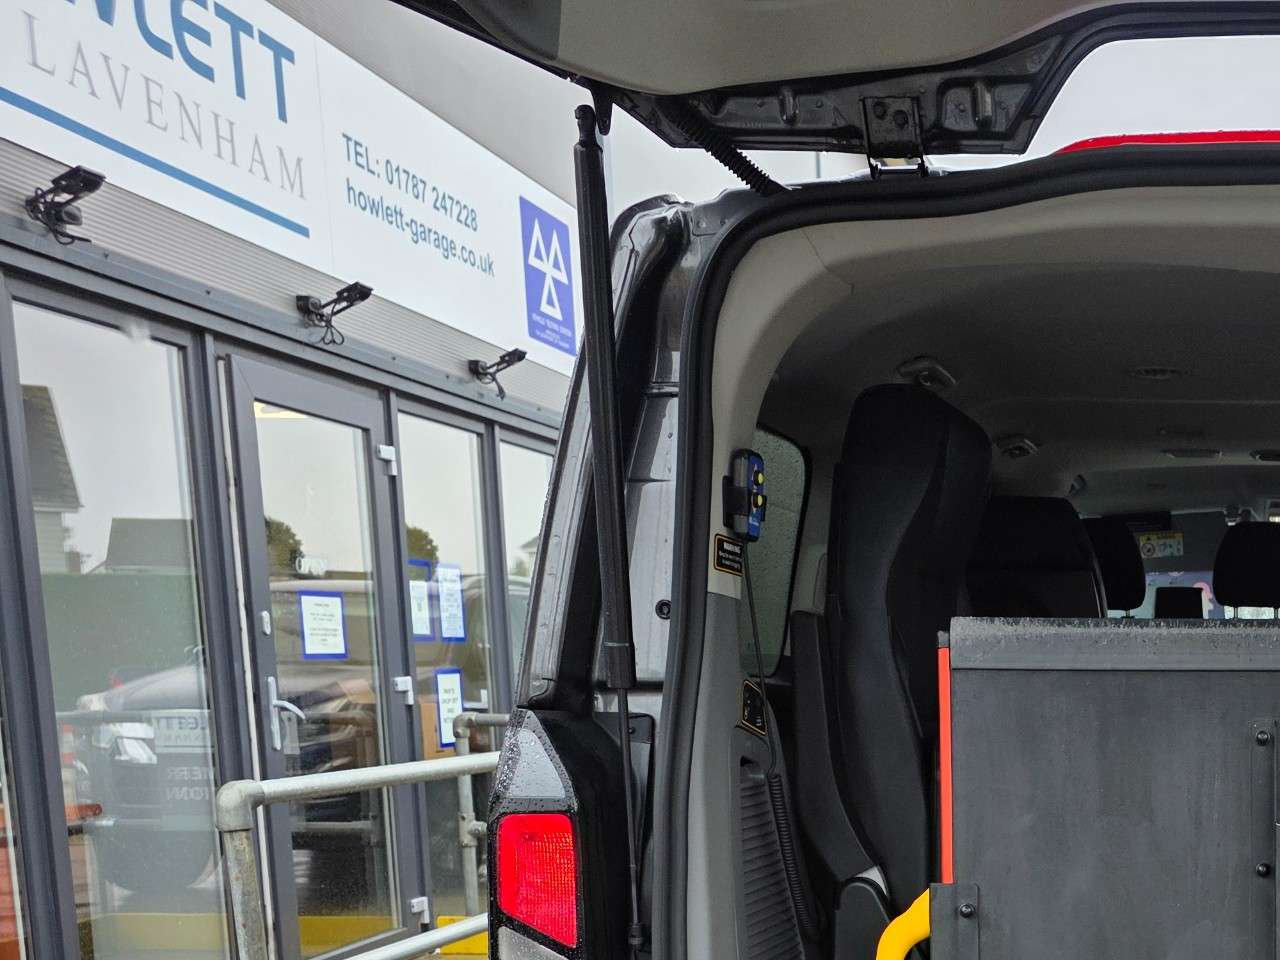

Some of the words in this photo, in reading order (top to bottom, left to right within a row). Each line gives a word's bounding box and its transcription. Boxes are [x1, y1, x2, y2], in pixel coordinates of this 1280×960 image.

[21, 8, 307, 200] LAVENHAM
[62, 0, 296, 124] LETT
[342, 132, 381, 178] TEL:
[385, 159, 427, 203] 01787
[431, 186, 478, 232] 247228
[346, 177, 495, 278] howlett-garage.co.uk
